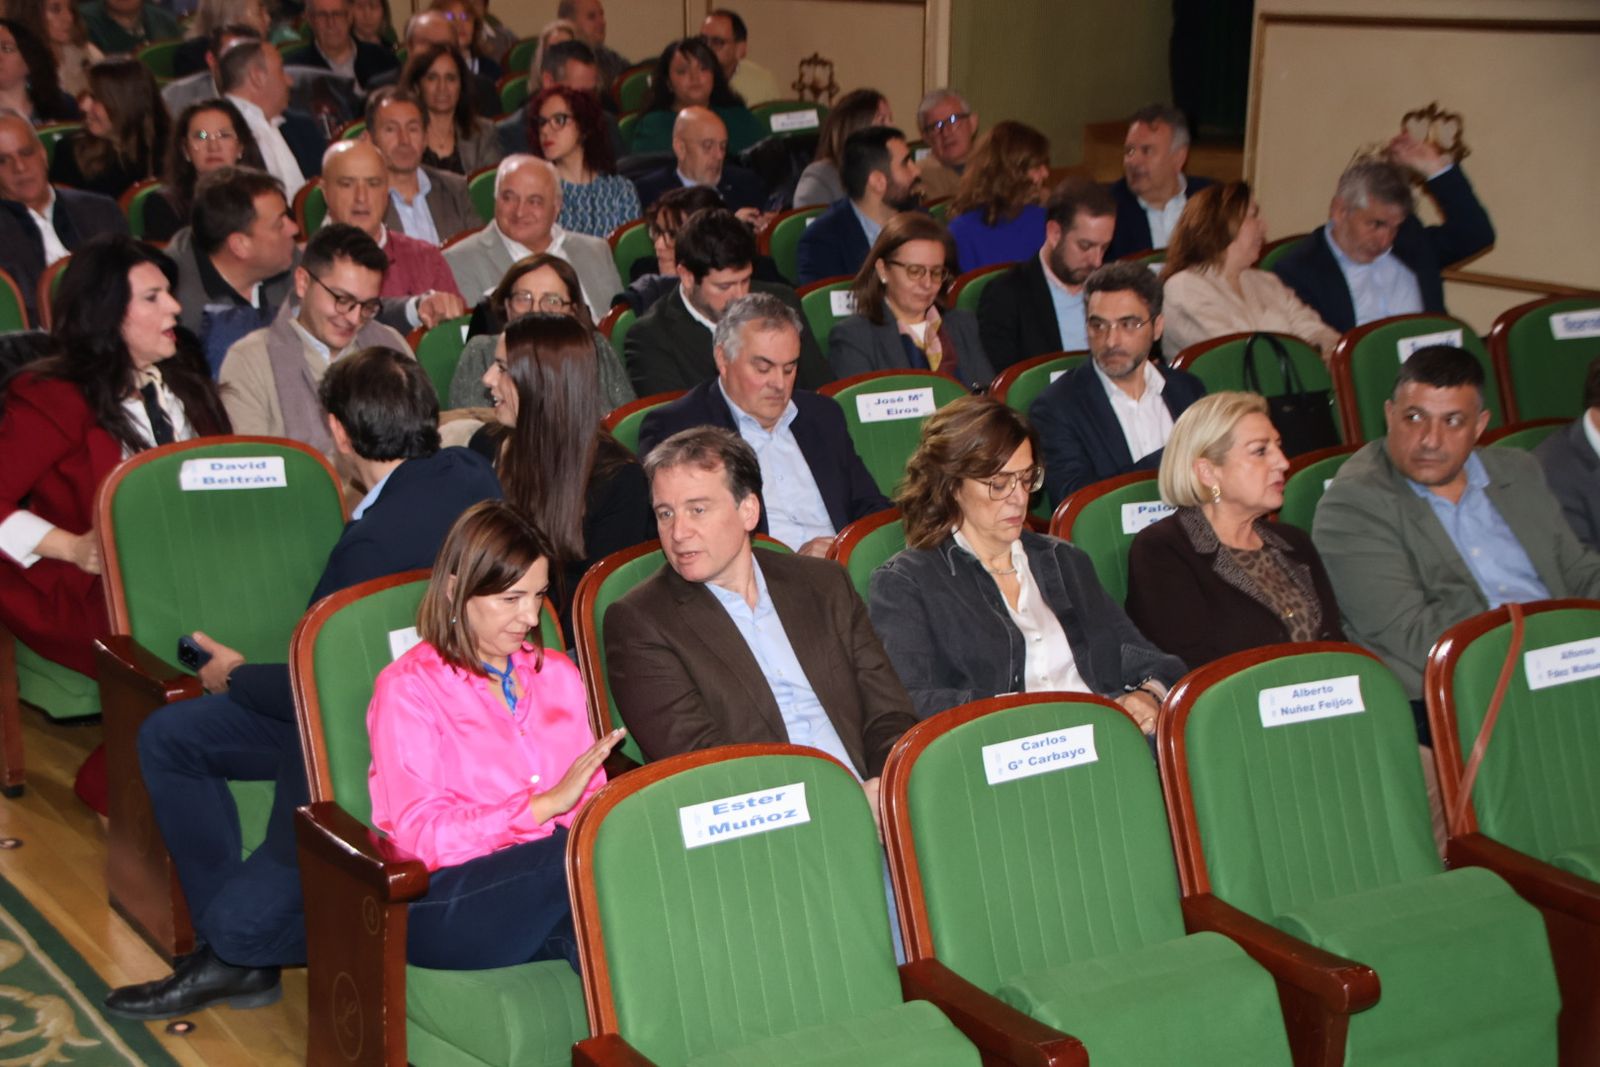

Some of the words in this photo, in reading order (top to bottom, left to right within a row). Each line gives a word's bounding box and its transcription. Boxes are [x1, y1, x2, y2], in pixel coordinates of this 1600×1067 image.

[874, 396, 904, 405] José
[886, 407, 919, 415] Eiros
[209, 461, 267, 471] David
[202, 475, 278, 485] Beltrán
[1292, 685, 1334, 698] Alberto
[1318, 697, 1353, 710] Feijóo
[1021, 735, 1067, 751] Carlos
[1028, 747, 1086, 766] Carbayo
[712, 792, 786, 815] Ester
[708, 808, 797, 835] Muñoz
